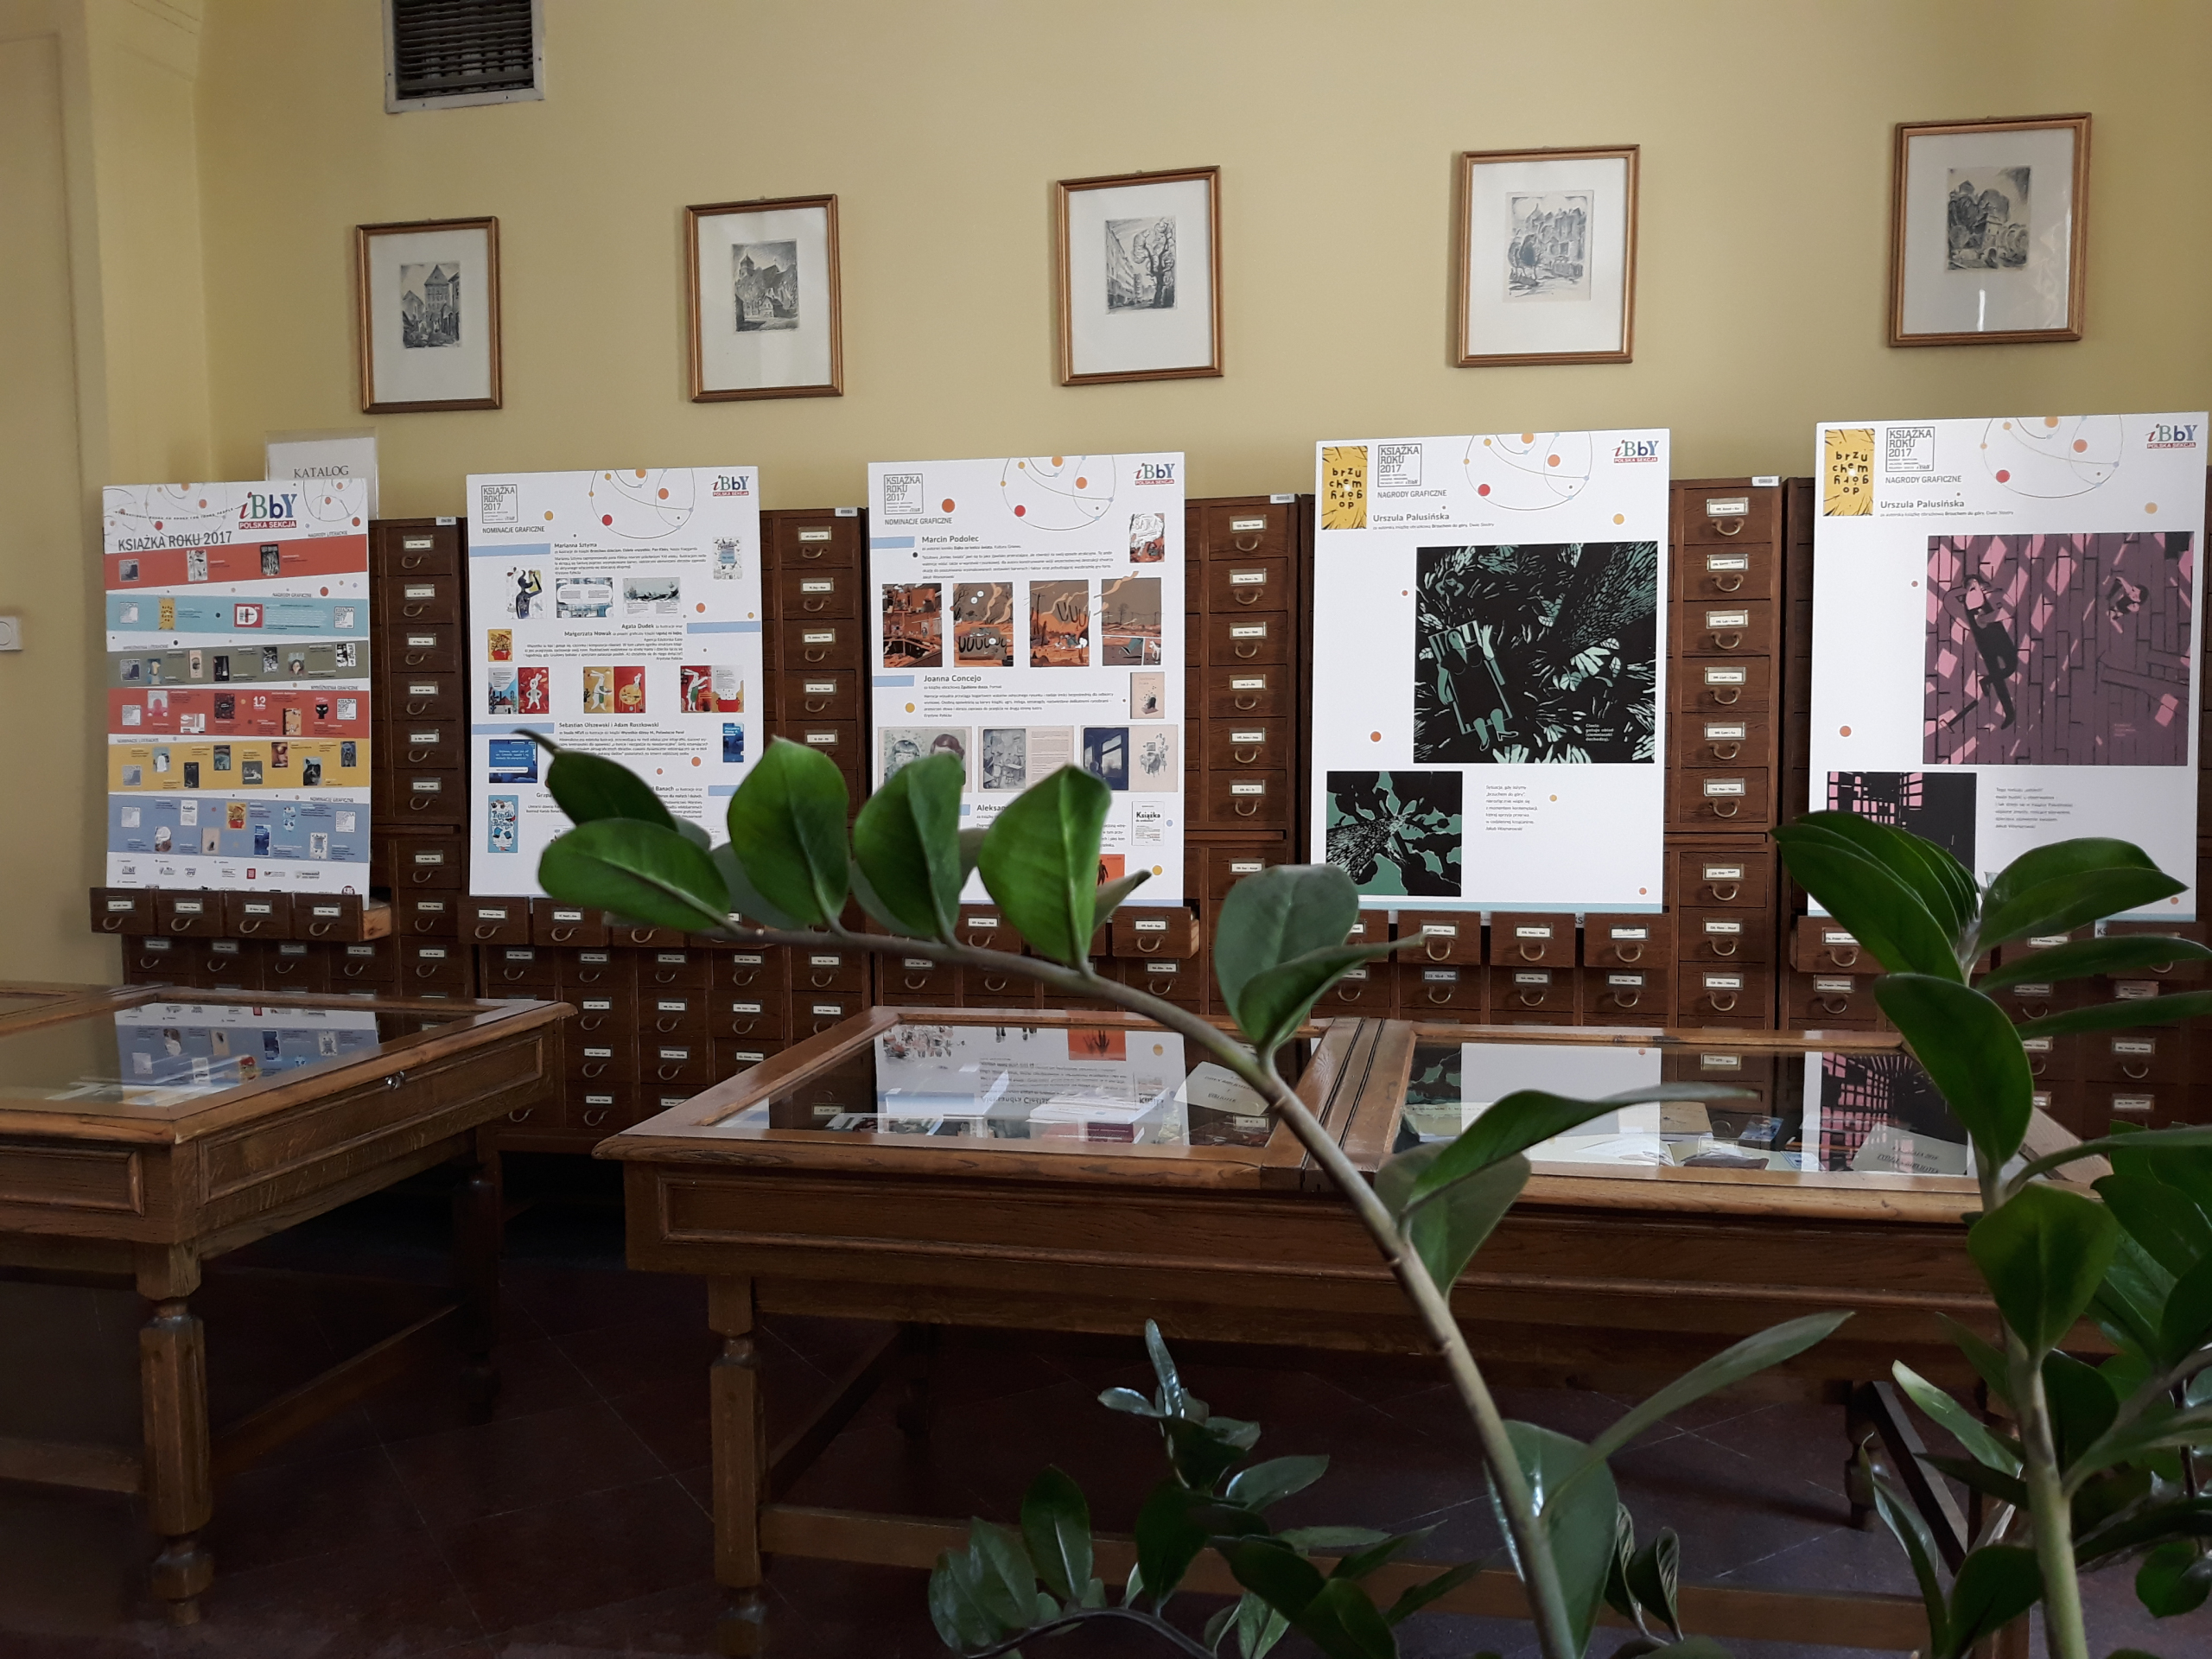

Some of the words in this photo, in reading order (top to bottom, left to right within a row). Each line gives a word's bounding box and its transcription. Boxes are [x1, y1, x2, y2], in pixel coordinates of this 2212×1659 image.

[1889, 428, 1933, 440] KSIĄŻKA
[1889, 439, 1916, 448] ROKU
[1380, 445, 1420, 455] KSIĄŻKA
[1889, 448, 1912, 457] 2017
[1380, 455, 1405, 464] ROKU
[294, 465, 349, 478] KATALOG
[886, 475, 921, 485] KSIĄŻKA
[483, 486, 515, 495] KSIĄŻKA
[483, 494, 504, 503] ROKU
[238, 491, 298, 519] iBbY
[1916, 499, 1965, 508] Palusińska
[239, 521, 268, 530] POLSKA
[118, 535, 166, 551] KSIĄŻKA
[168, 533, 200, 547] ROKU
[203, 531, 232, 544] 2017
[1136, 810, 1161, 820] Książka
